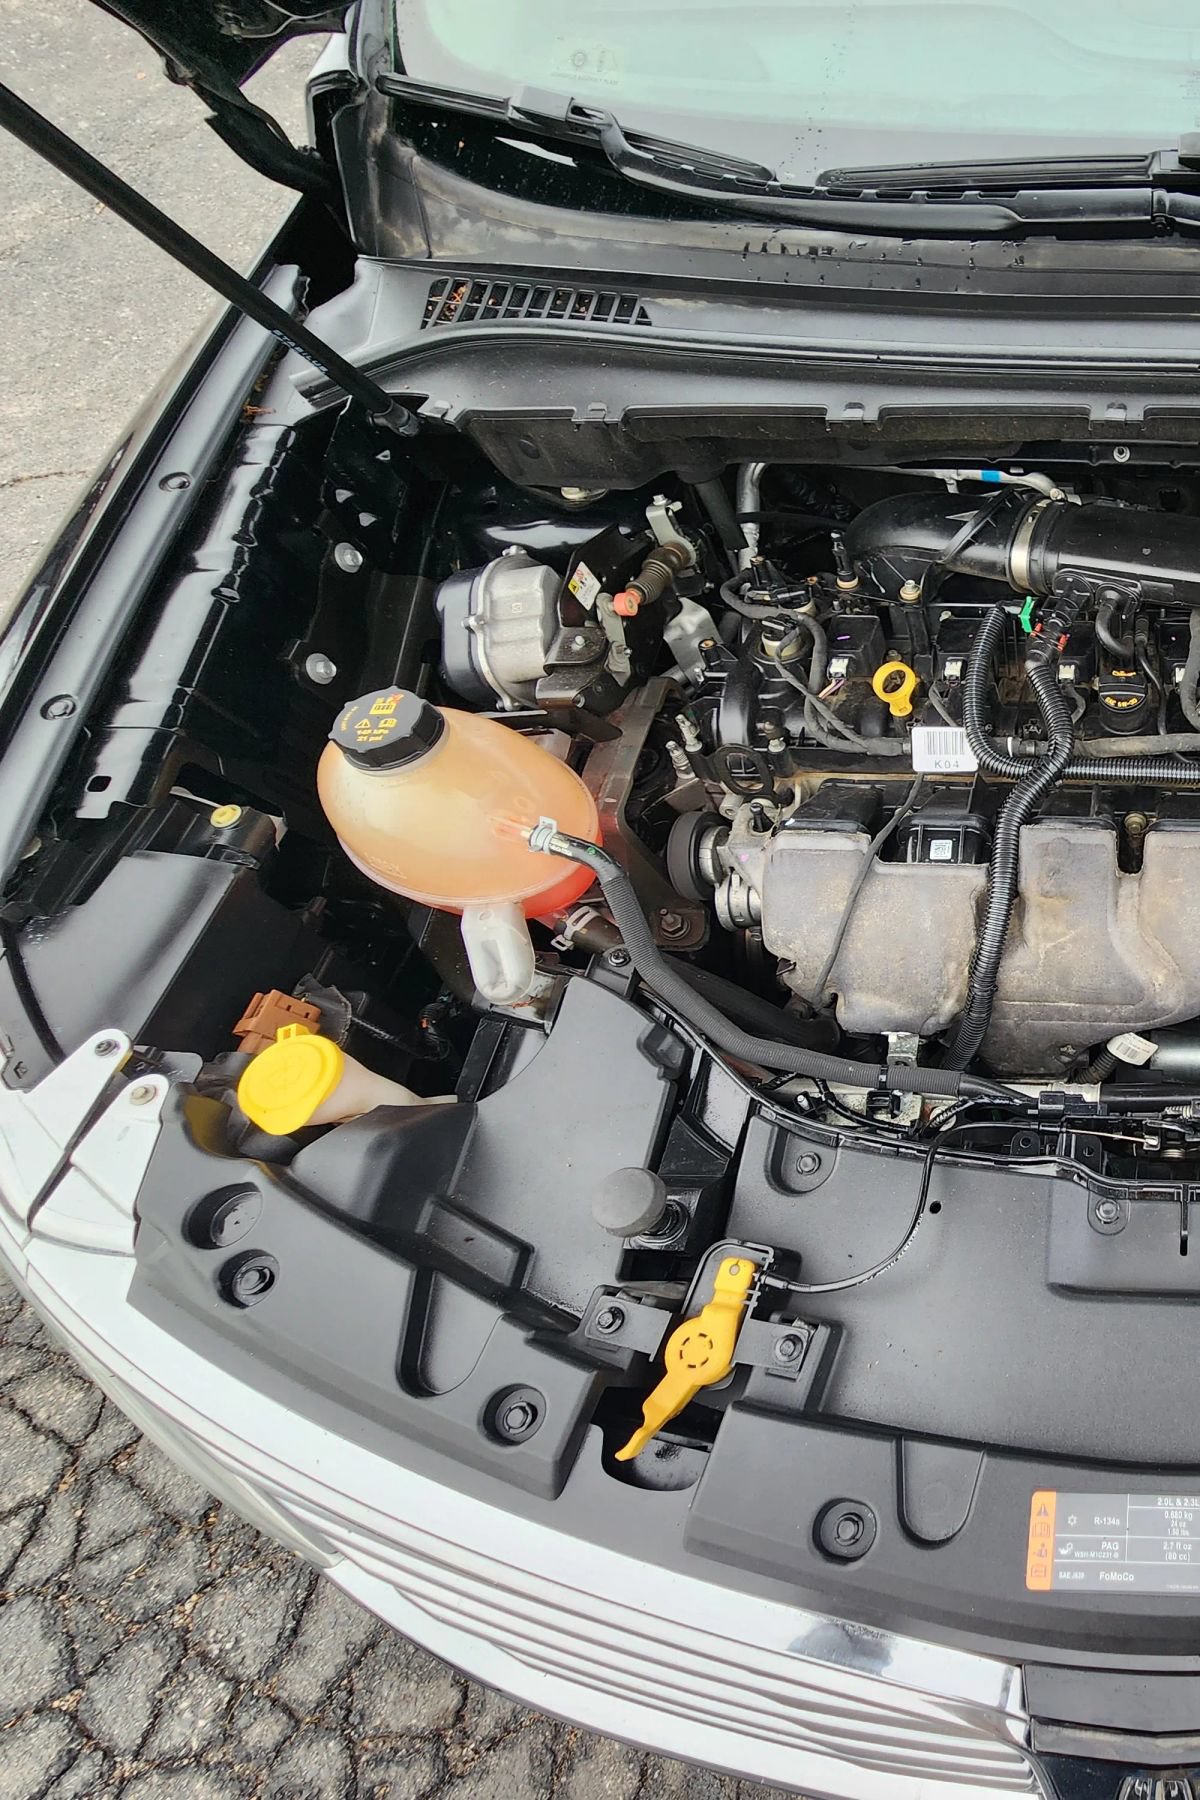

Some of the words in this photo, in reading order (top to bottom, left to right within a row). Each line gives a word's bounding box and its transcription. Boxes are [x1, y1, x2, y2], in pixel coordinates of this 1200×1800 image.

[272, 328, 329, 372] STABILUS
[934, 760, 960, 769] K04
[1101, 1541, 1119, 1551] PAG
[1099, 1571, 1135, 1582] FoMoCo
